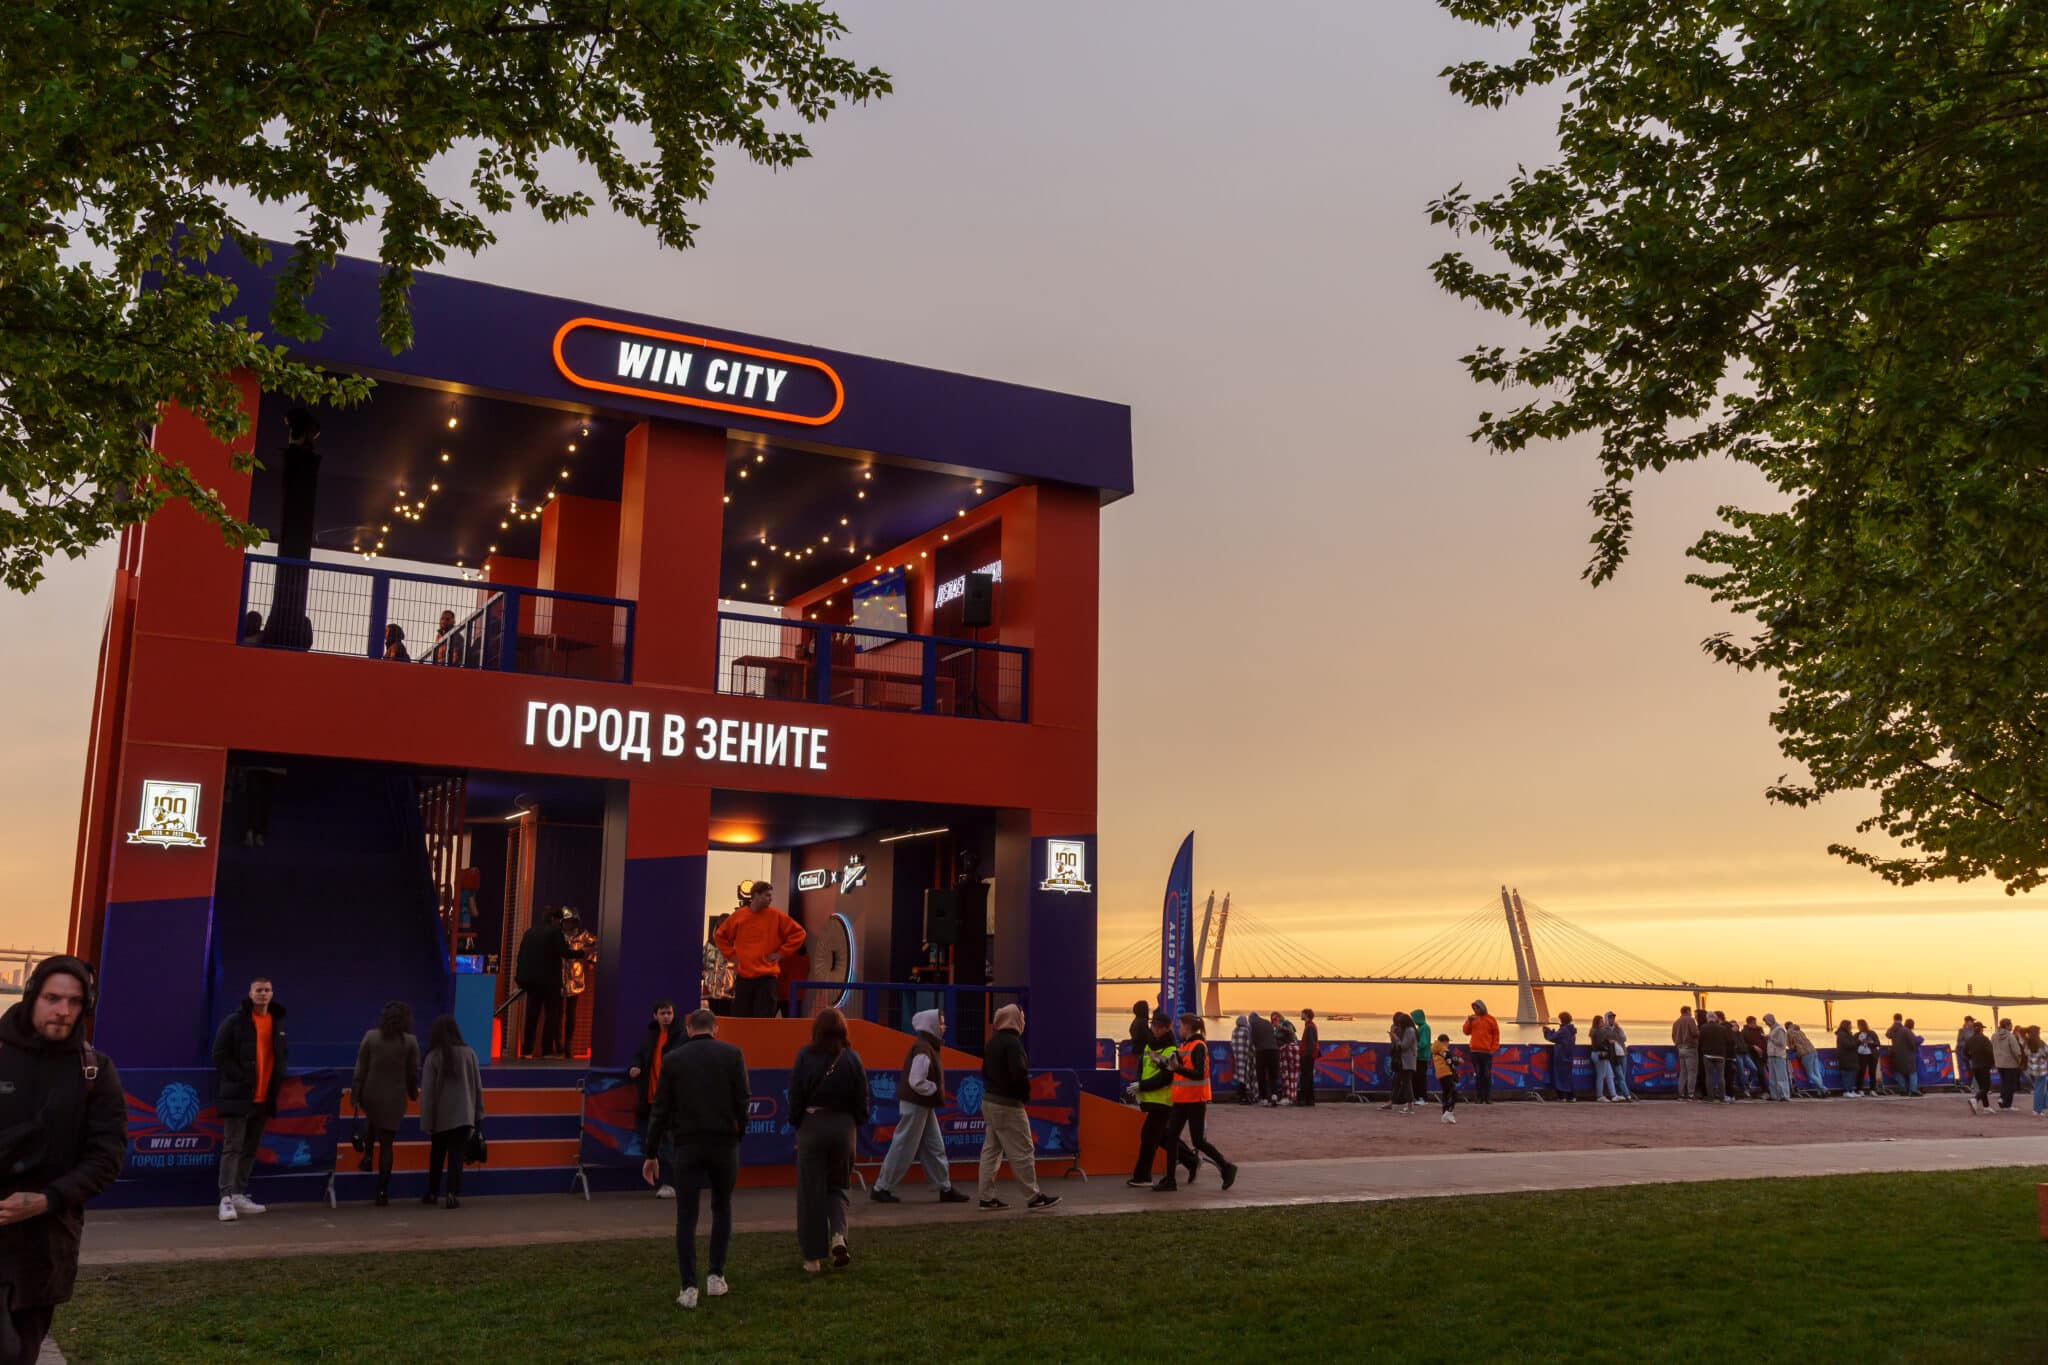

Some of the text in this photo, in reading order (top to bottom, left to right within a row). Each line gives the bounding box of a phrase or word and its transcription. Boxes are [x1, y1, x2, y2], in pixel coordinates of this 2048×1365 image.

[617, 341, 788, 402] WIN CITY
[525, 700, 829, 770] ГОРОД В ЗЕНИТЕ
[1167, 921, 1177, 1000] WIN CITY
[747, 1102, 760, 1112] TY
[954, 1121, 968, 1130] WIN
[151, 1138, 199, 1149] WIN CITY
[132, 1155, 165, 1168] ГОРОД
[177, 1154, 216, 1167] ЗЕНИТЕ
